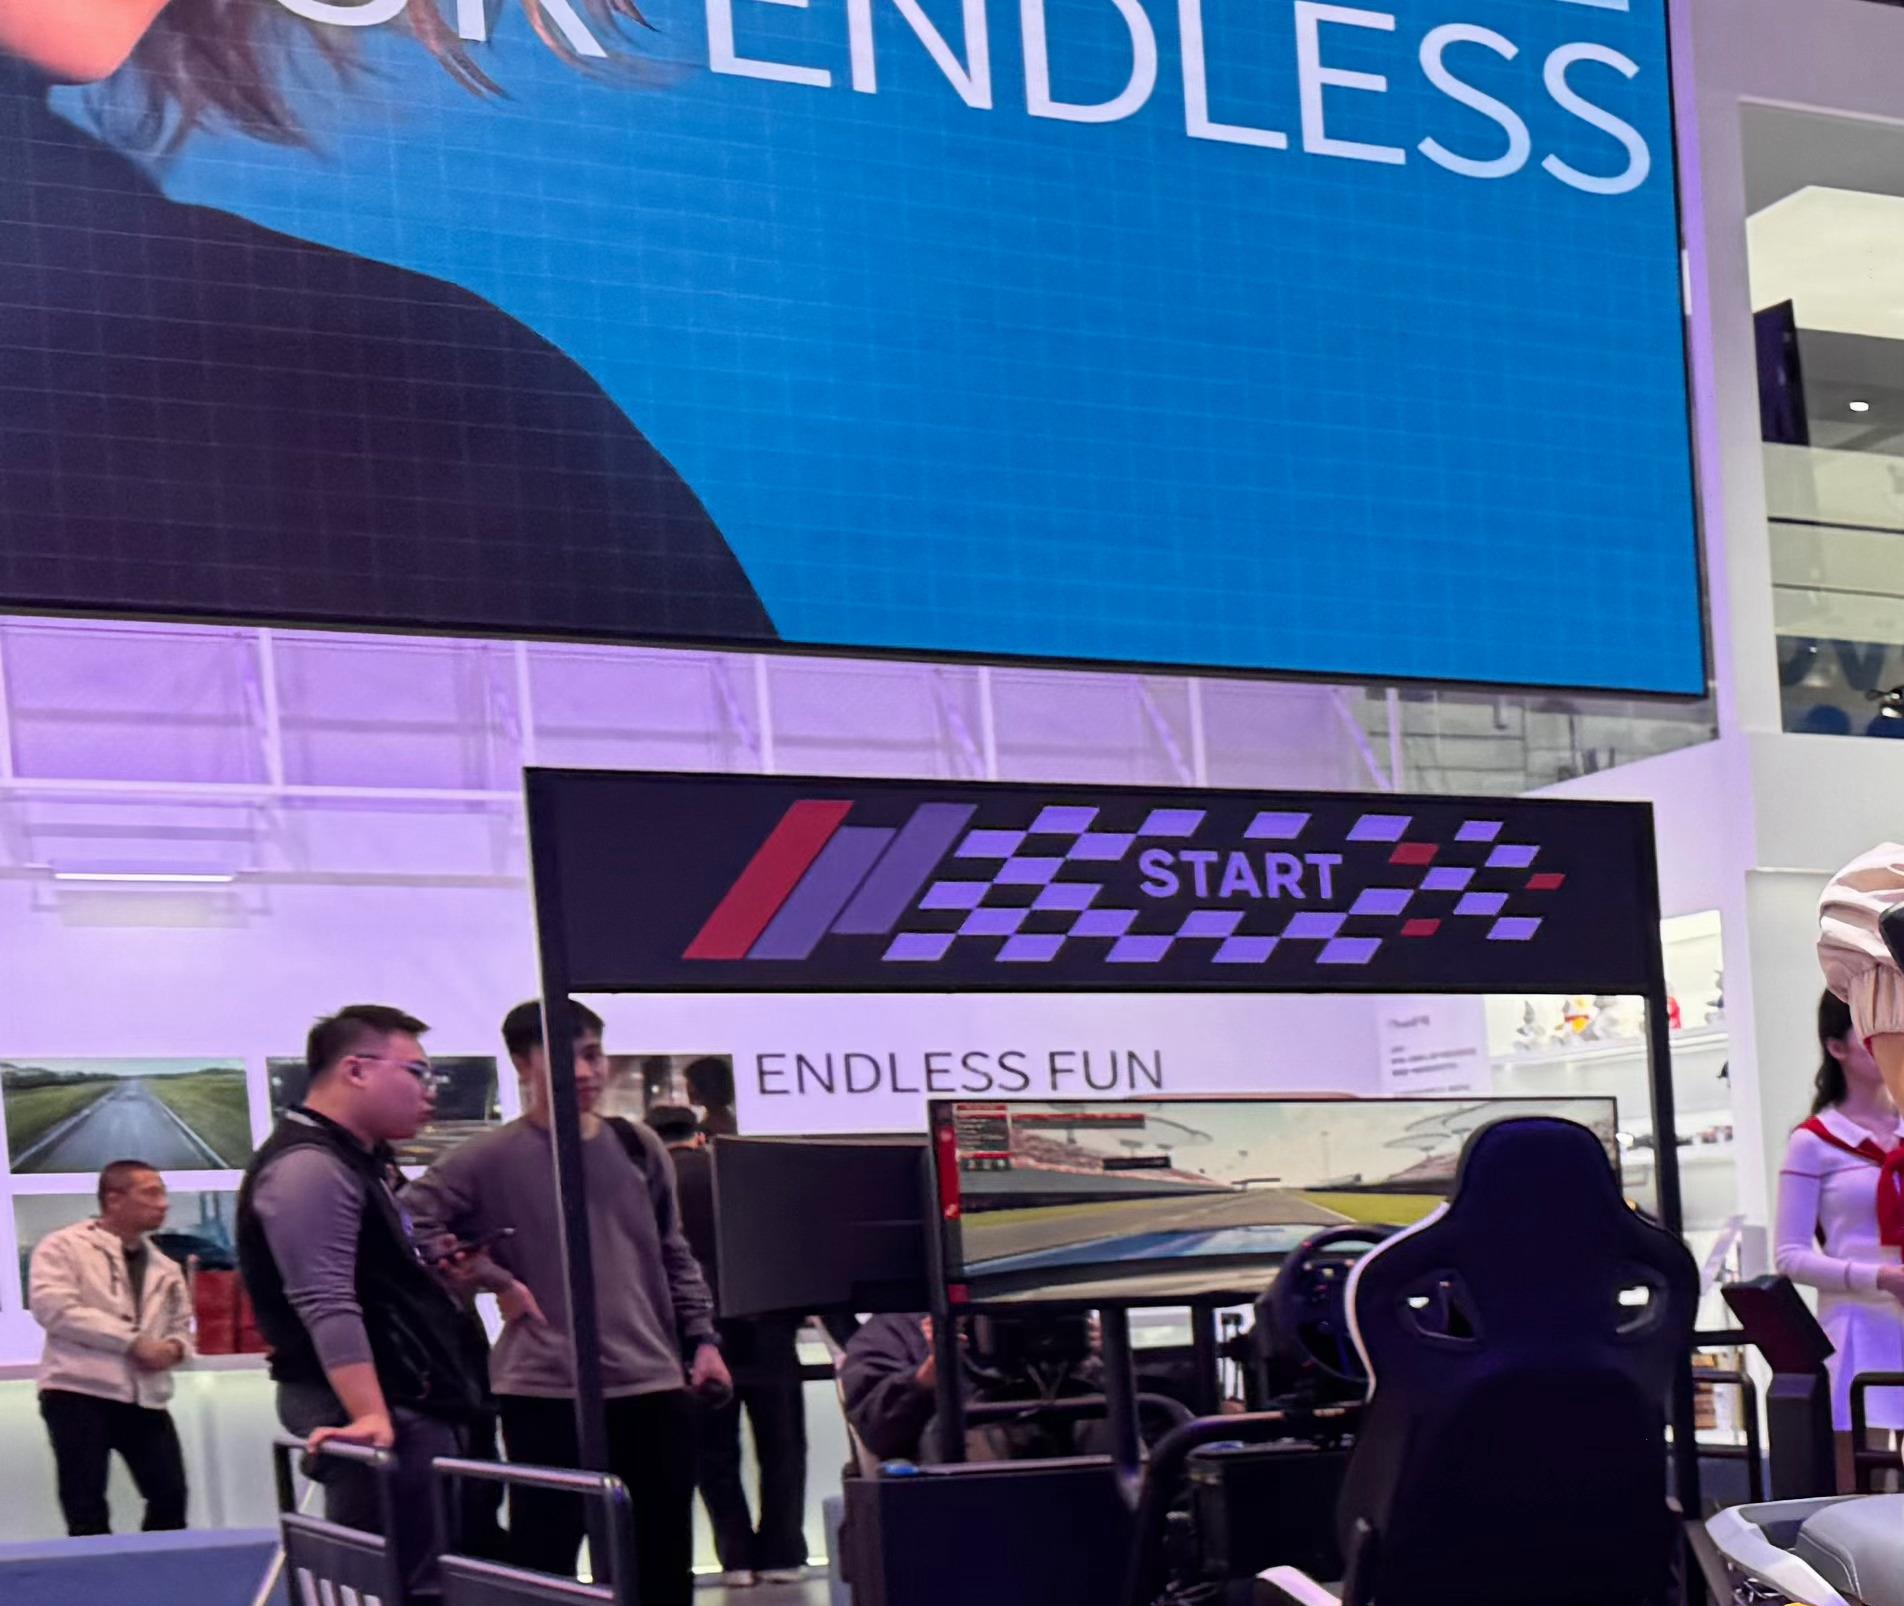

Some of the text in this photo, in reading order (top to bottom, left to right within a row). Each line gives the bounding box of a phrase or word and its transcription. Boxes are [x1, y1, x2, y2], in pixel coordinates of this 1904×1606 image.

[1139, 848, 1344, 901] START
[757, 1048, 1164, 1097] ENDLESS FUN
